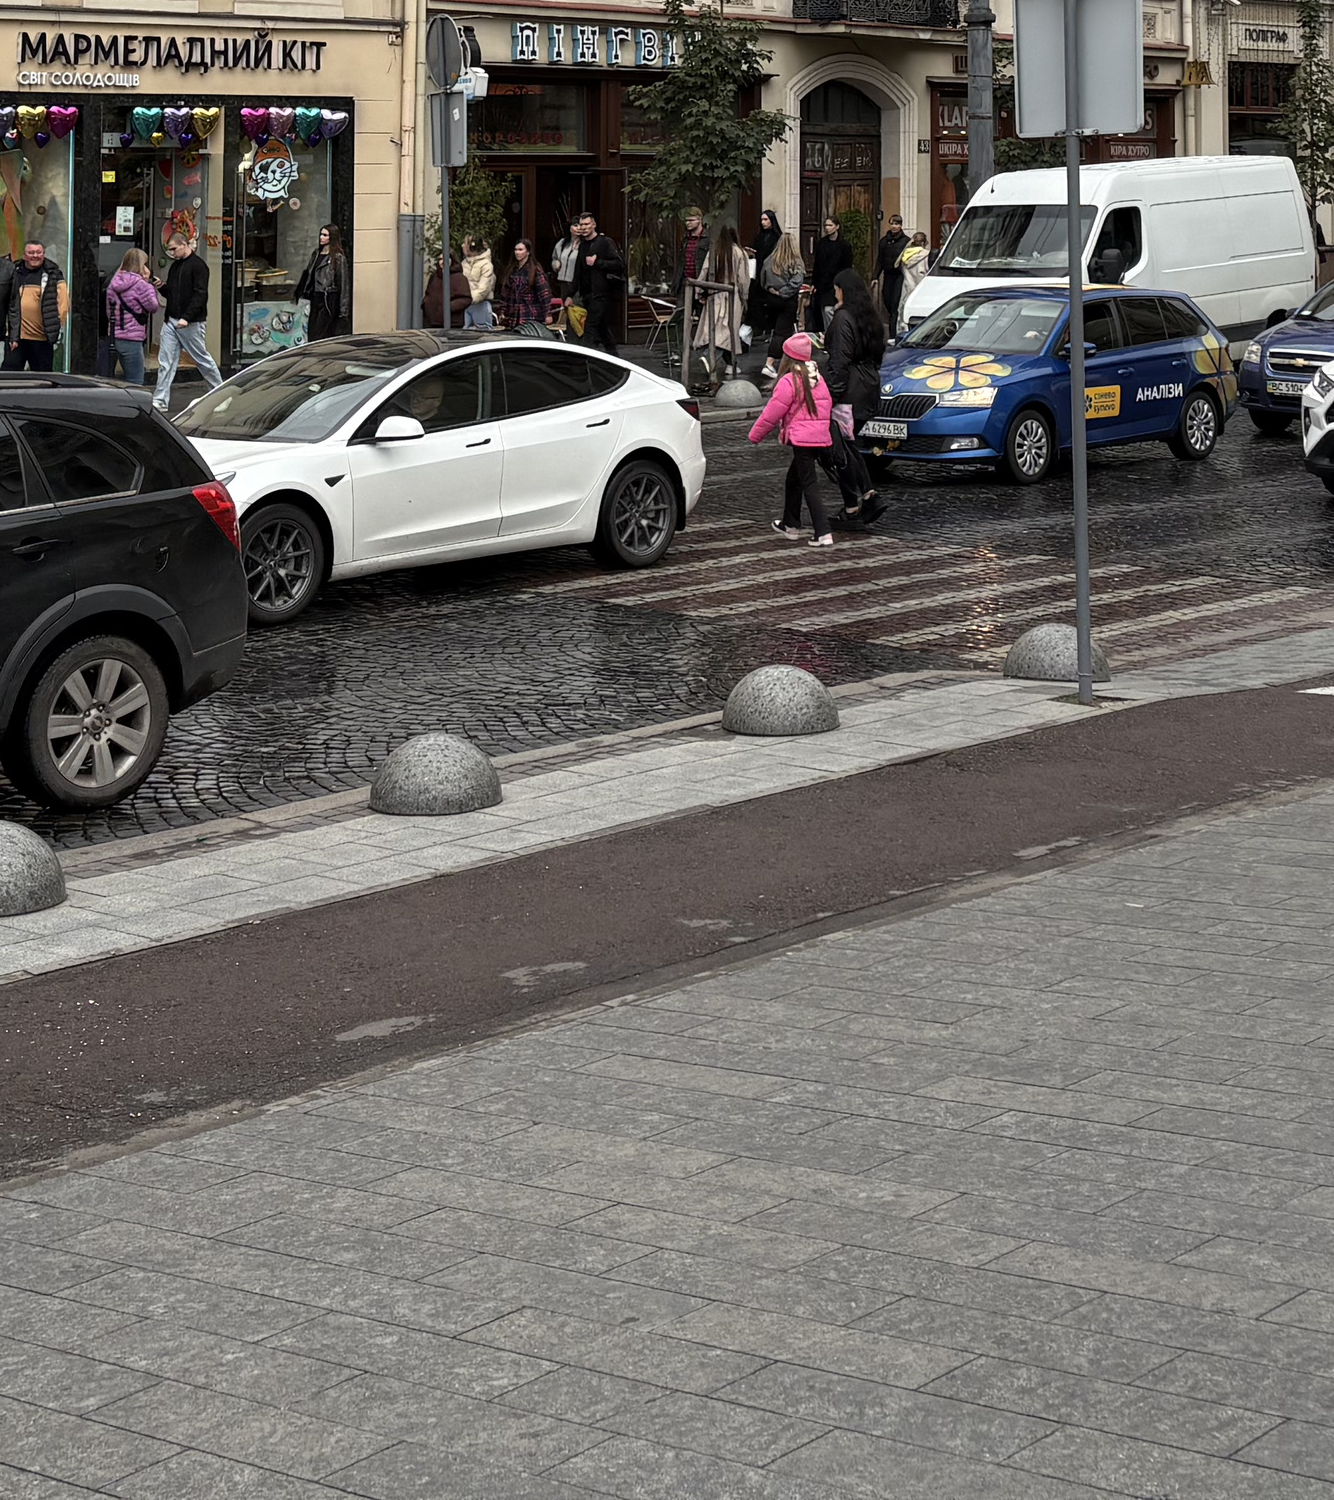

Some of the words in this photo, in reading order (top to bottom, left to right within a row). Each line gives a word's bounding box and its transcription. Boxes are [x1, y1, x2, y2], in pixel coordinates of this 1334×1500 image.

[1244, 28, 1289, 44] ПОЛІГРАФ
[19, 30, 272, 73] МАРМЕЛАДНИЙ
[278, 40, 327, 71] КІТ
[511, 22, 701, 67] ПІНГВІ
[17, 71, 48, 86] СВІТ
[51, 71, 140, 88] СОЛОДОЩІВ
[919, 140, 930, 151] 43
[1110, 145, 1127, 156] КІРА
[1135, 383, 1183, 402] АНАЛІЗИ
[872, 423, 892, 435] 6296
[892, 424, 906, 436] BK
